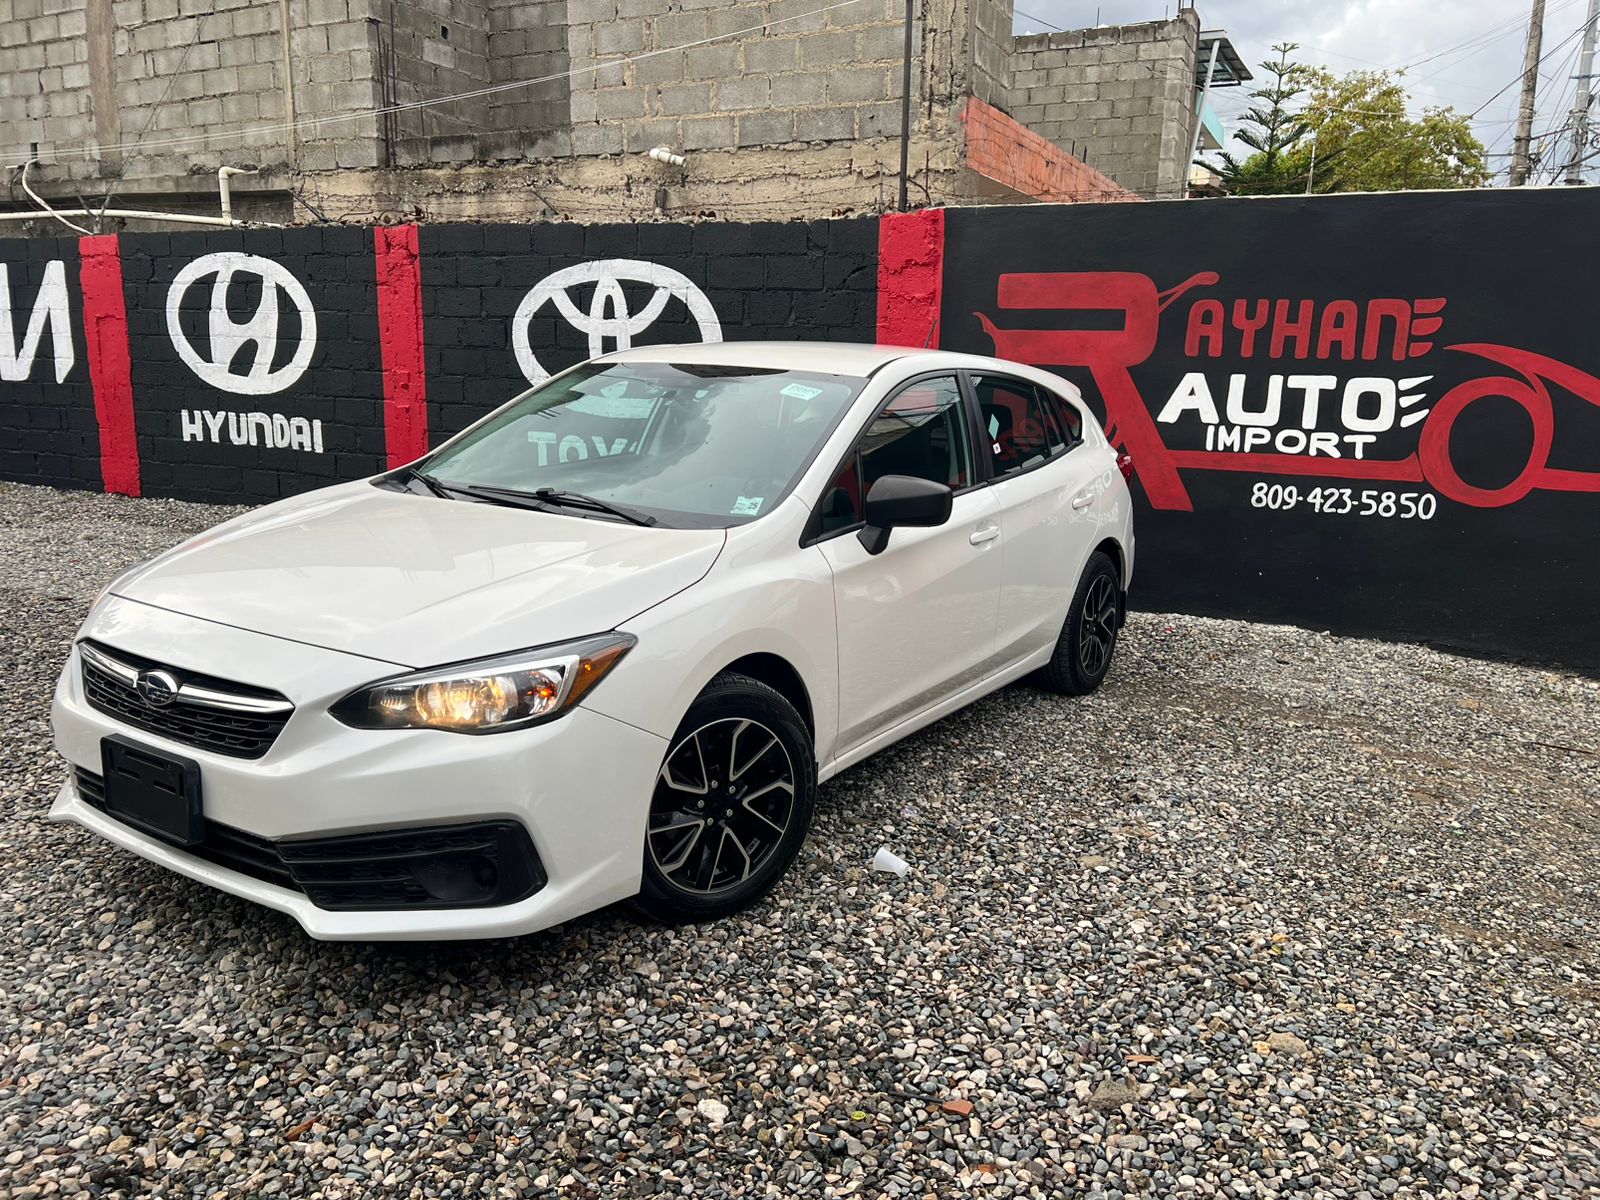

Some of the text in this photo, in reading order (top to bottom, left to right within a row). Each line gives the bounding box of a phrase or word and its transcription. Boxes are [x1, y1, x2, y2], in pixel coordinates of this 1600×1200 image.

[1156, 372, 1397, 433] AUTO
[180, 409, 324, 454] HYUNDAI
[1205, 424, 1377, 460] IMPORT
[1250, 482, 1437, 520] 809-423-5850
